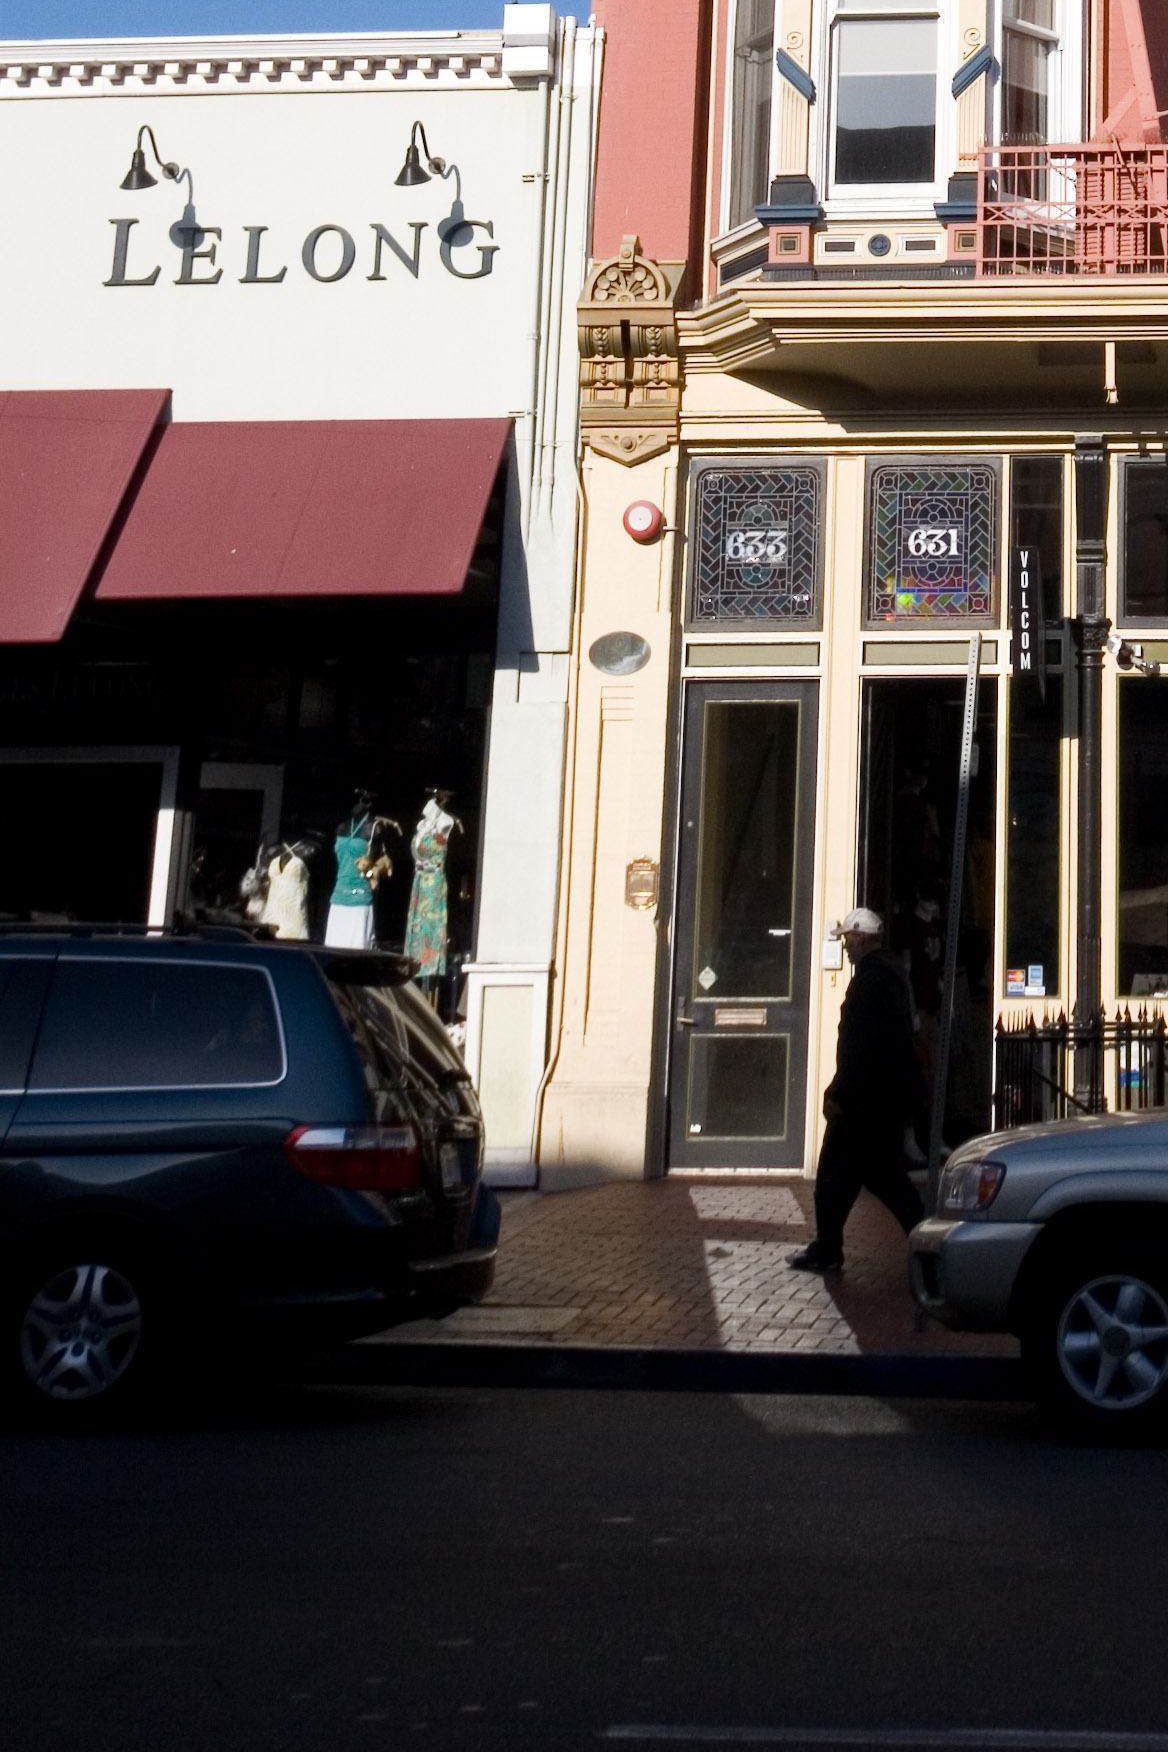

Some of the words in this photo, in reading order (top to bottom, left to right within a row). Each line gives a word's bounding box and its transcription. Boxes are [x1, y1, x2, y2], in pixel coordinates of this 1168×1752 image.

[101, 217, 501, 287] LELONG
[726, 531, 788, 559] 633
[907, 528, 961, 556] 631
[1020, 550, 1031, 670] VOLCOM
